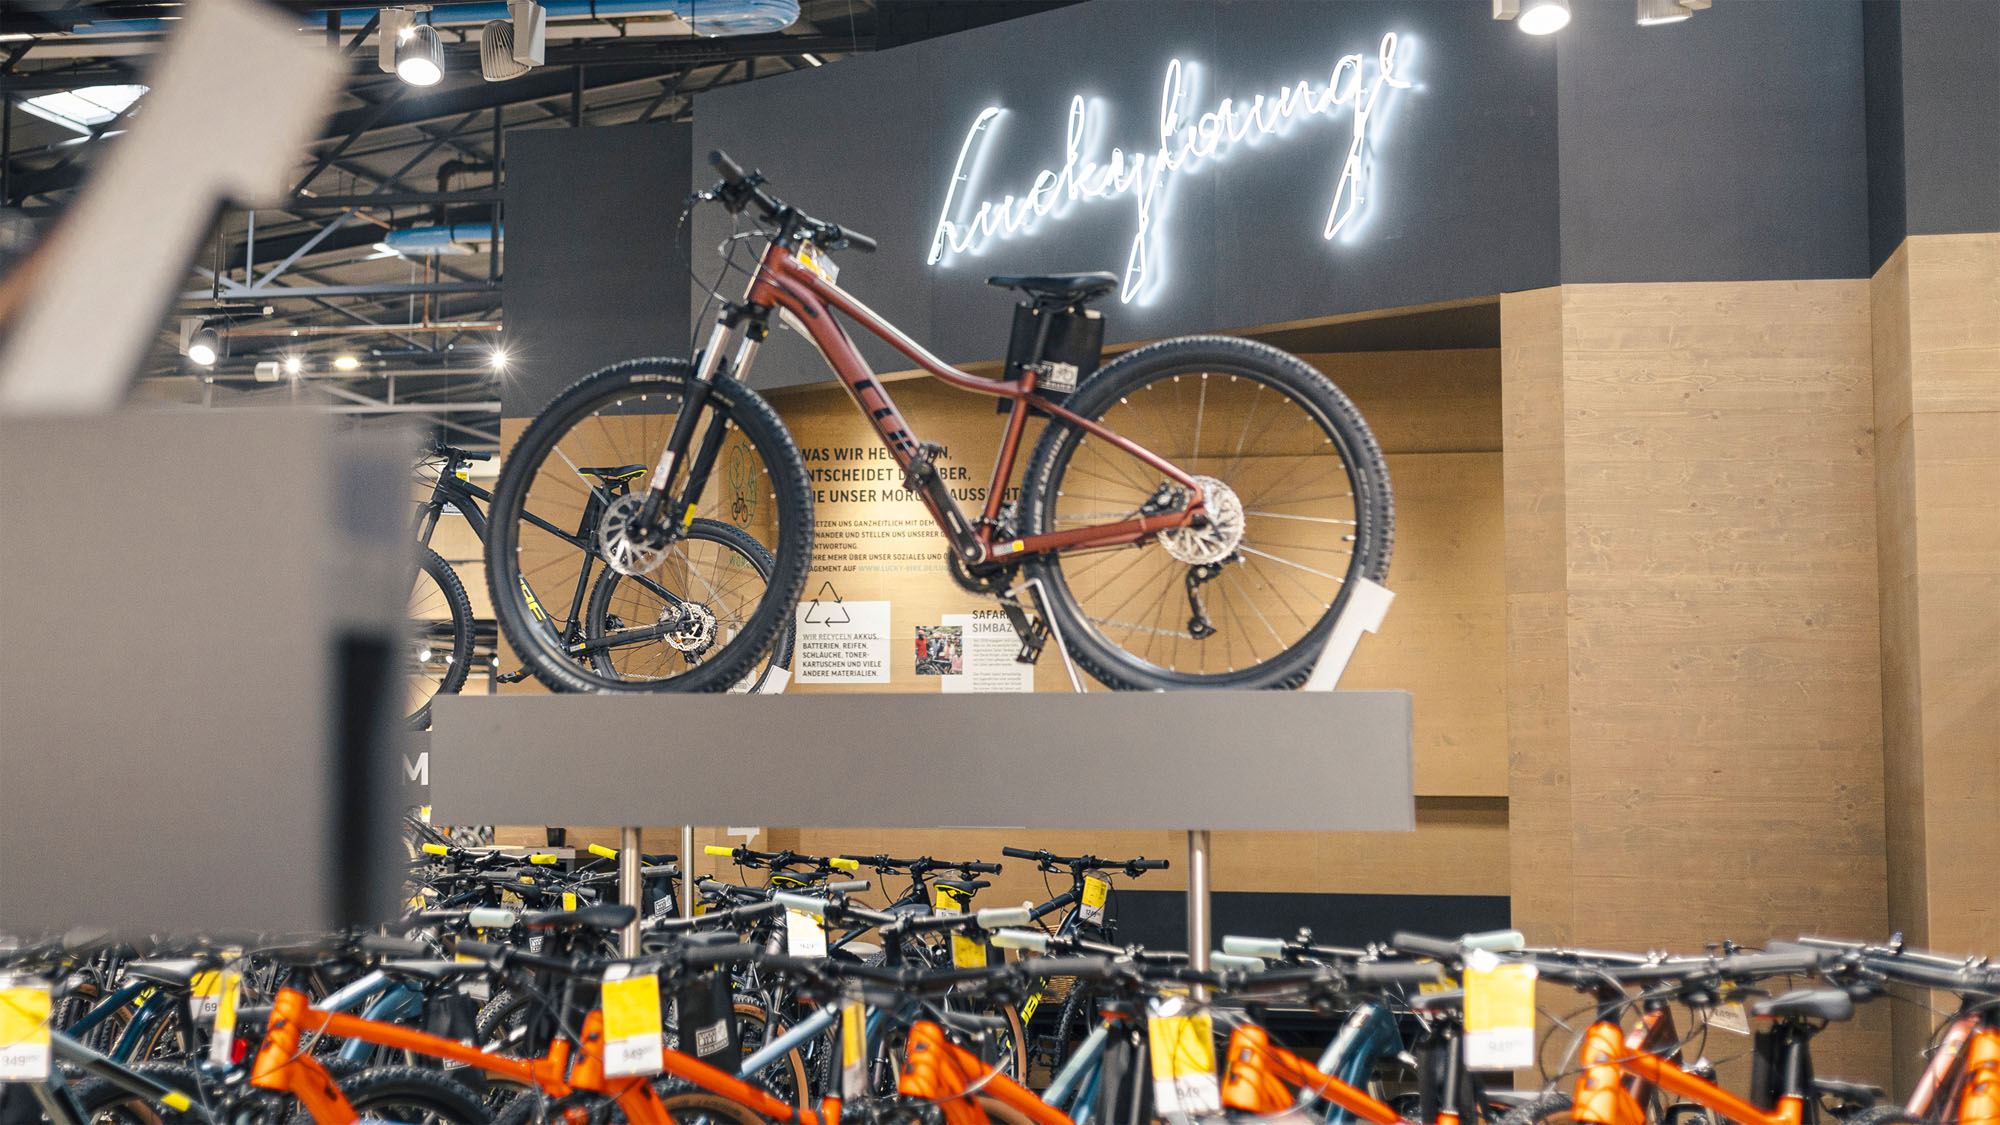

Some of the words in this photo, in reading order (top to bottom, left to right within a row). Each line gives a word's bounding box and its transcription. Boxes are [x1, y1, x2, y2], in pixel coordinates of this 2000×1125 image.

[801, 447, 830, 461] WAS
[834, 447, 863, 461] WIR
[869, 447, 895, 460] HEU
[806, 468, 893, 482] NTSCHEIDET
[813, 489, 825, 503] IE
[829, 489, 877, 503] UNSER
[815, 520, 837, 528] ETZEN
[838, 520, 852, 528] UNS
[854, 519, 903, 527] GANZHEITLICH
[905, 519, 917, 527] MIT
[920, 519, 935, 527] DEM
[908, 530, 939, 538] UNSERER
[814, 542, 857, 550] NTWORTUNG
[812, 553, 826, 561] HRE
[828, 553, 847, 561] MEHR
[849, 552, 867, 561] ÜBER
[869, 553, 892, 561] UNSER
[893, 553, 926, 561] SOZIALES
[927, 553, 942, 561] UND
[972, 623, 1013, 633] SIMBAZ
[802, 633, 817, 641] WIR
[818, 633, 853, 641] RECYCELN
[845, 651, 870, 659] TONER-
[802, 660, 846, 668] KARTUSCHEN
[847, 660, 862, 668] UND
[862, 660, 881, 668] VIELE
[802, 669, 830, 677] ANDERE
